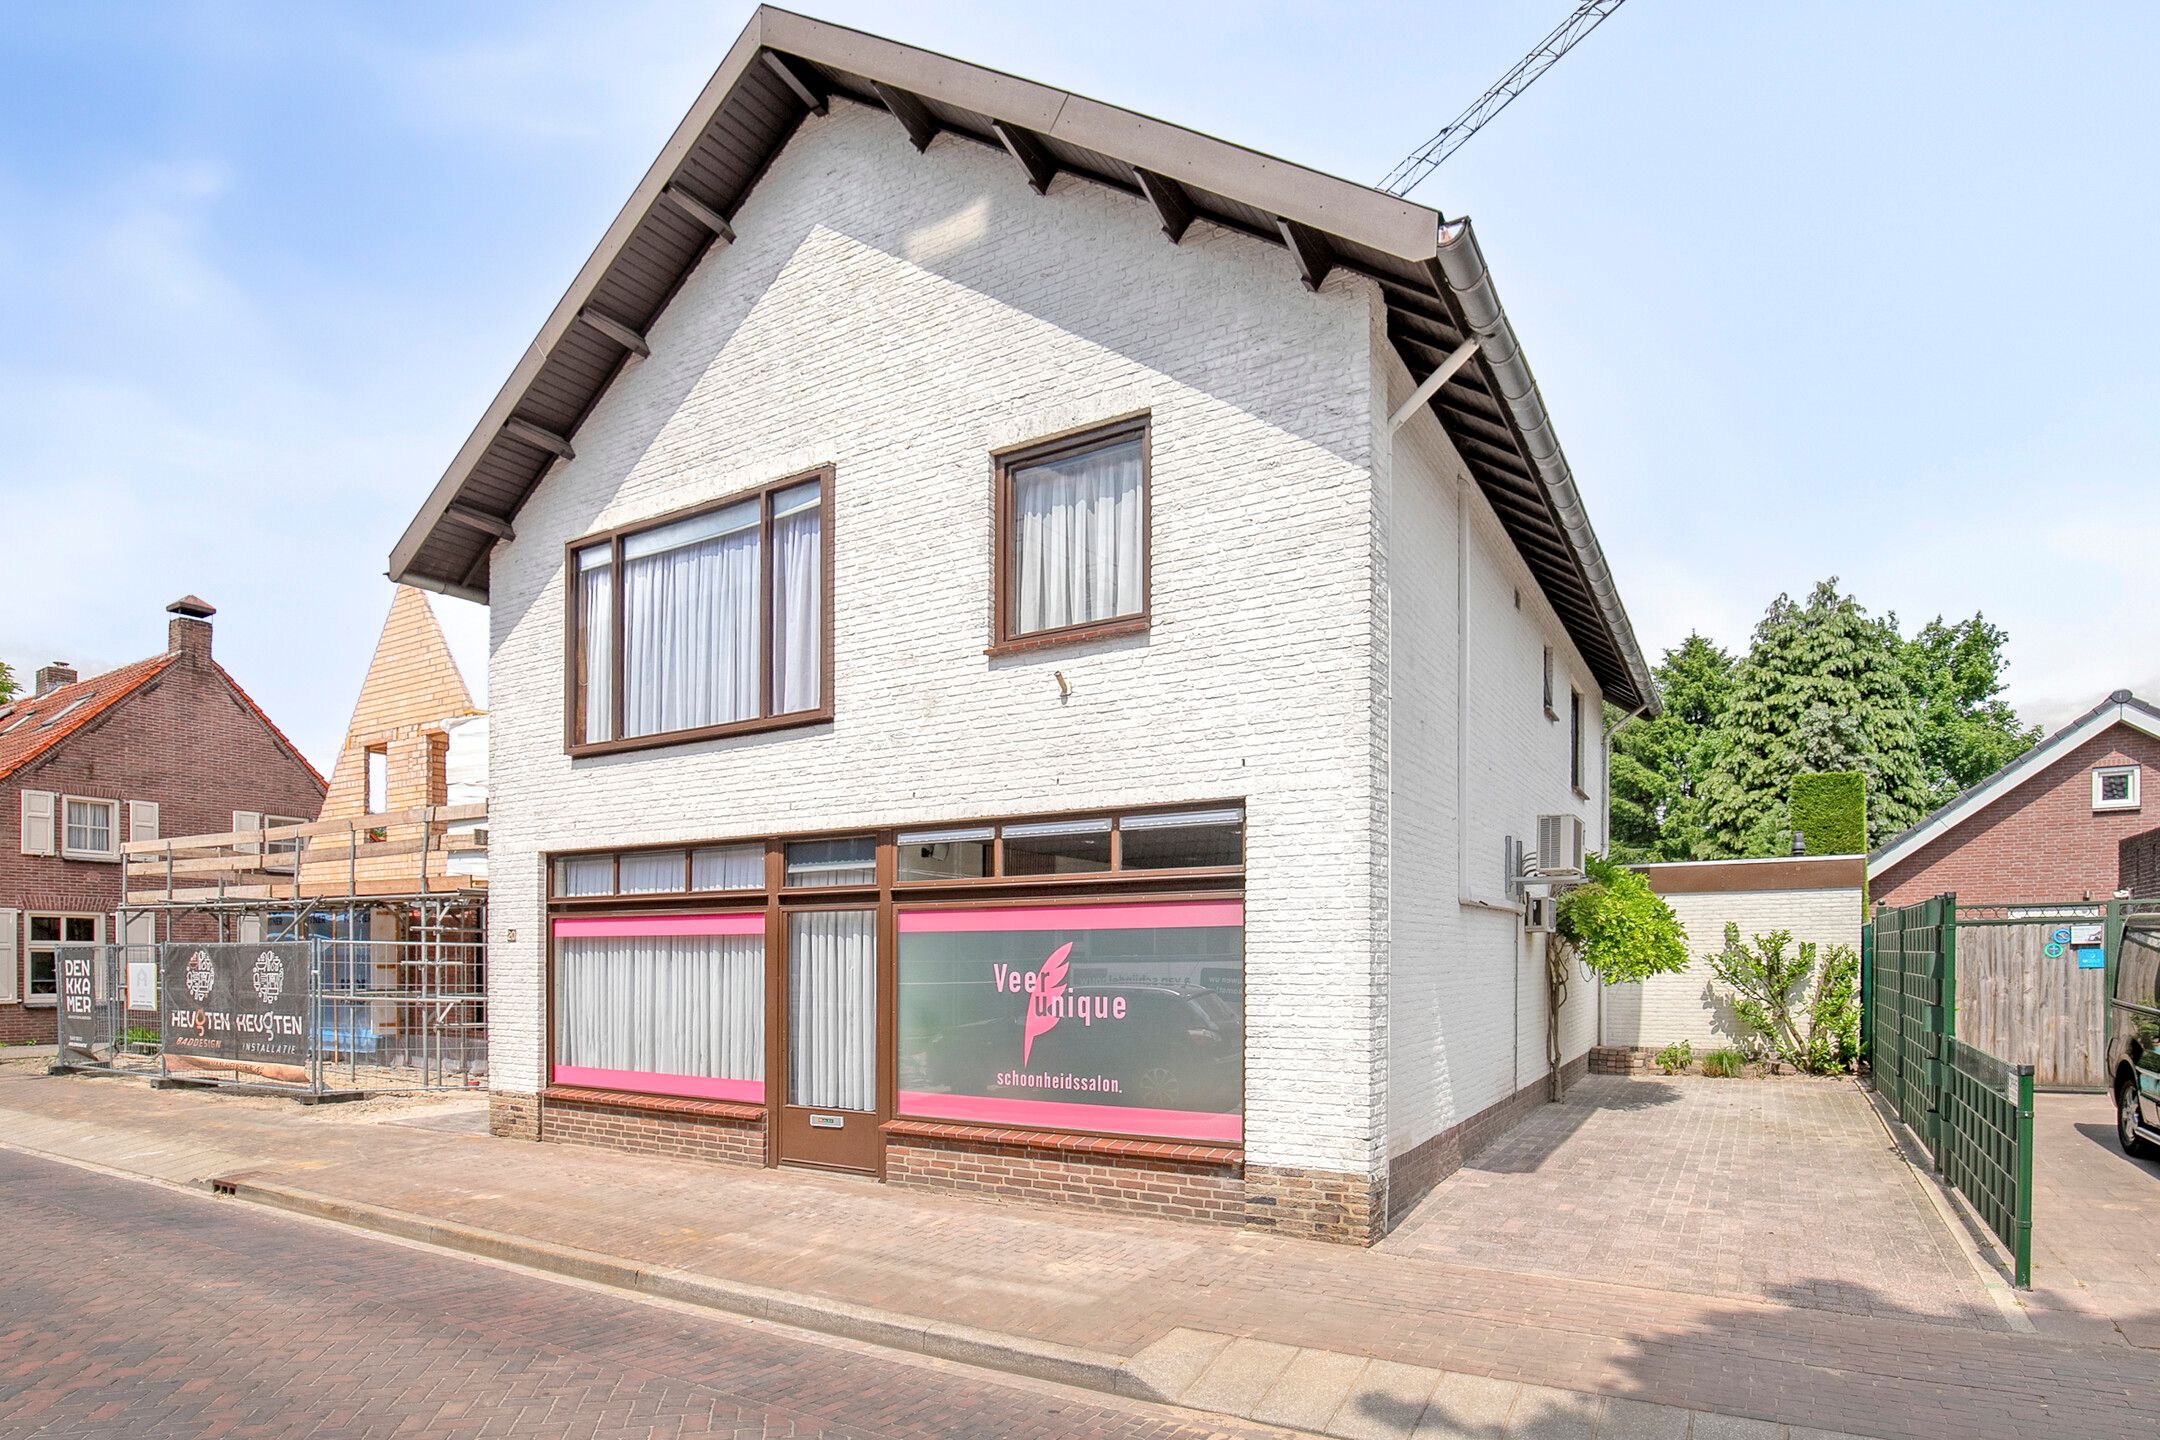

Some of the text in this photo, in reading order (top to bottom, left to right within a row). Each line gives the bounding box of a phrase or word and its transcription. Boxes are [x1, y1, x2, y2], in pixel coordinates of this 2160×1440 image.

[64, 959, 91, 977] DEN
[65, 977, 91, 995] KKA
[993, 963, 1050, 993] Veer
[66, 996, 92, 1013] MER
[1035, 988, 1127, 1026] unique
[176, 1037, 222, 1049] BADDESIGN
[242, 1043, 296, 1054] INSTALLATIE
[997, 1071, 1122, 1093] schoonheidssalon.
